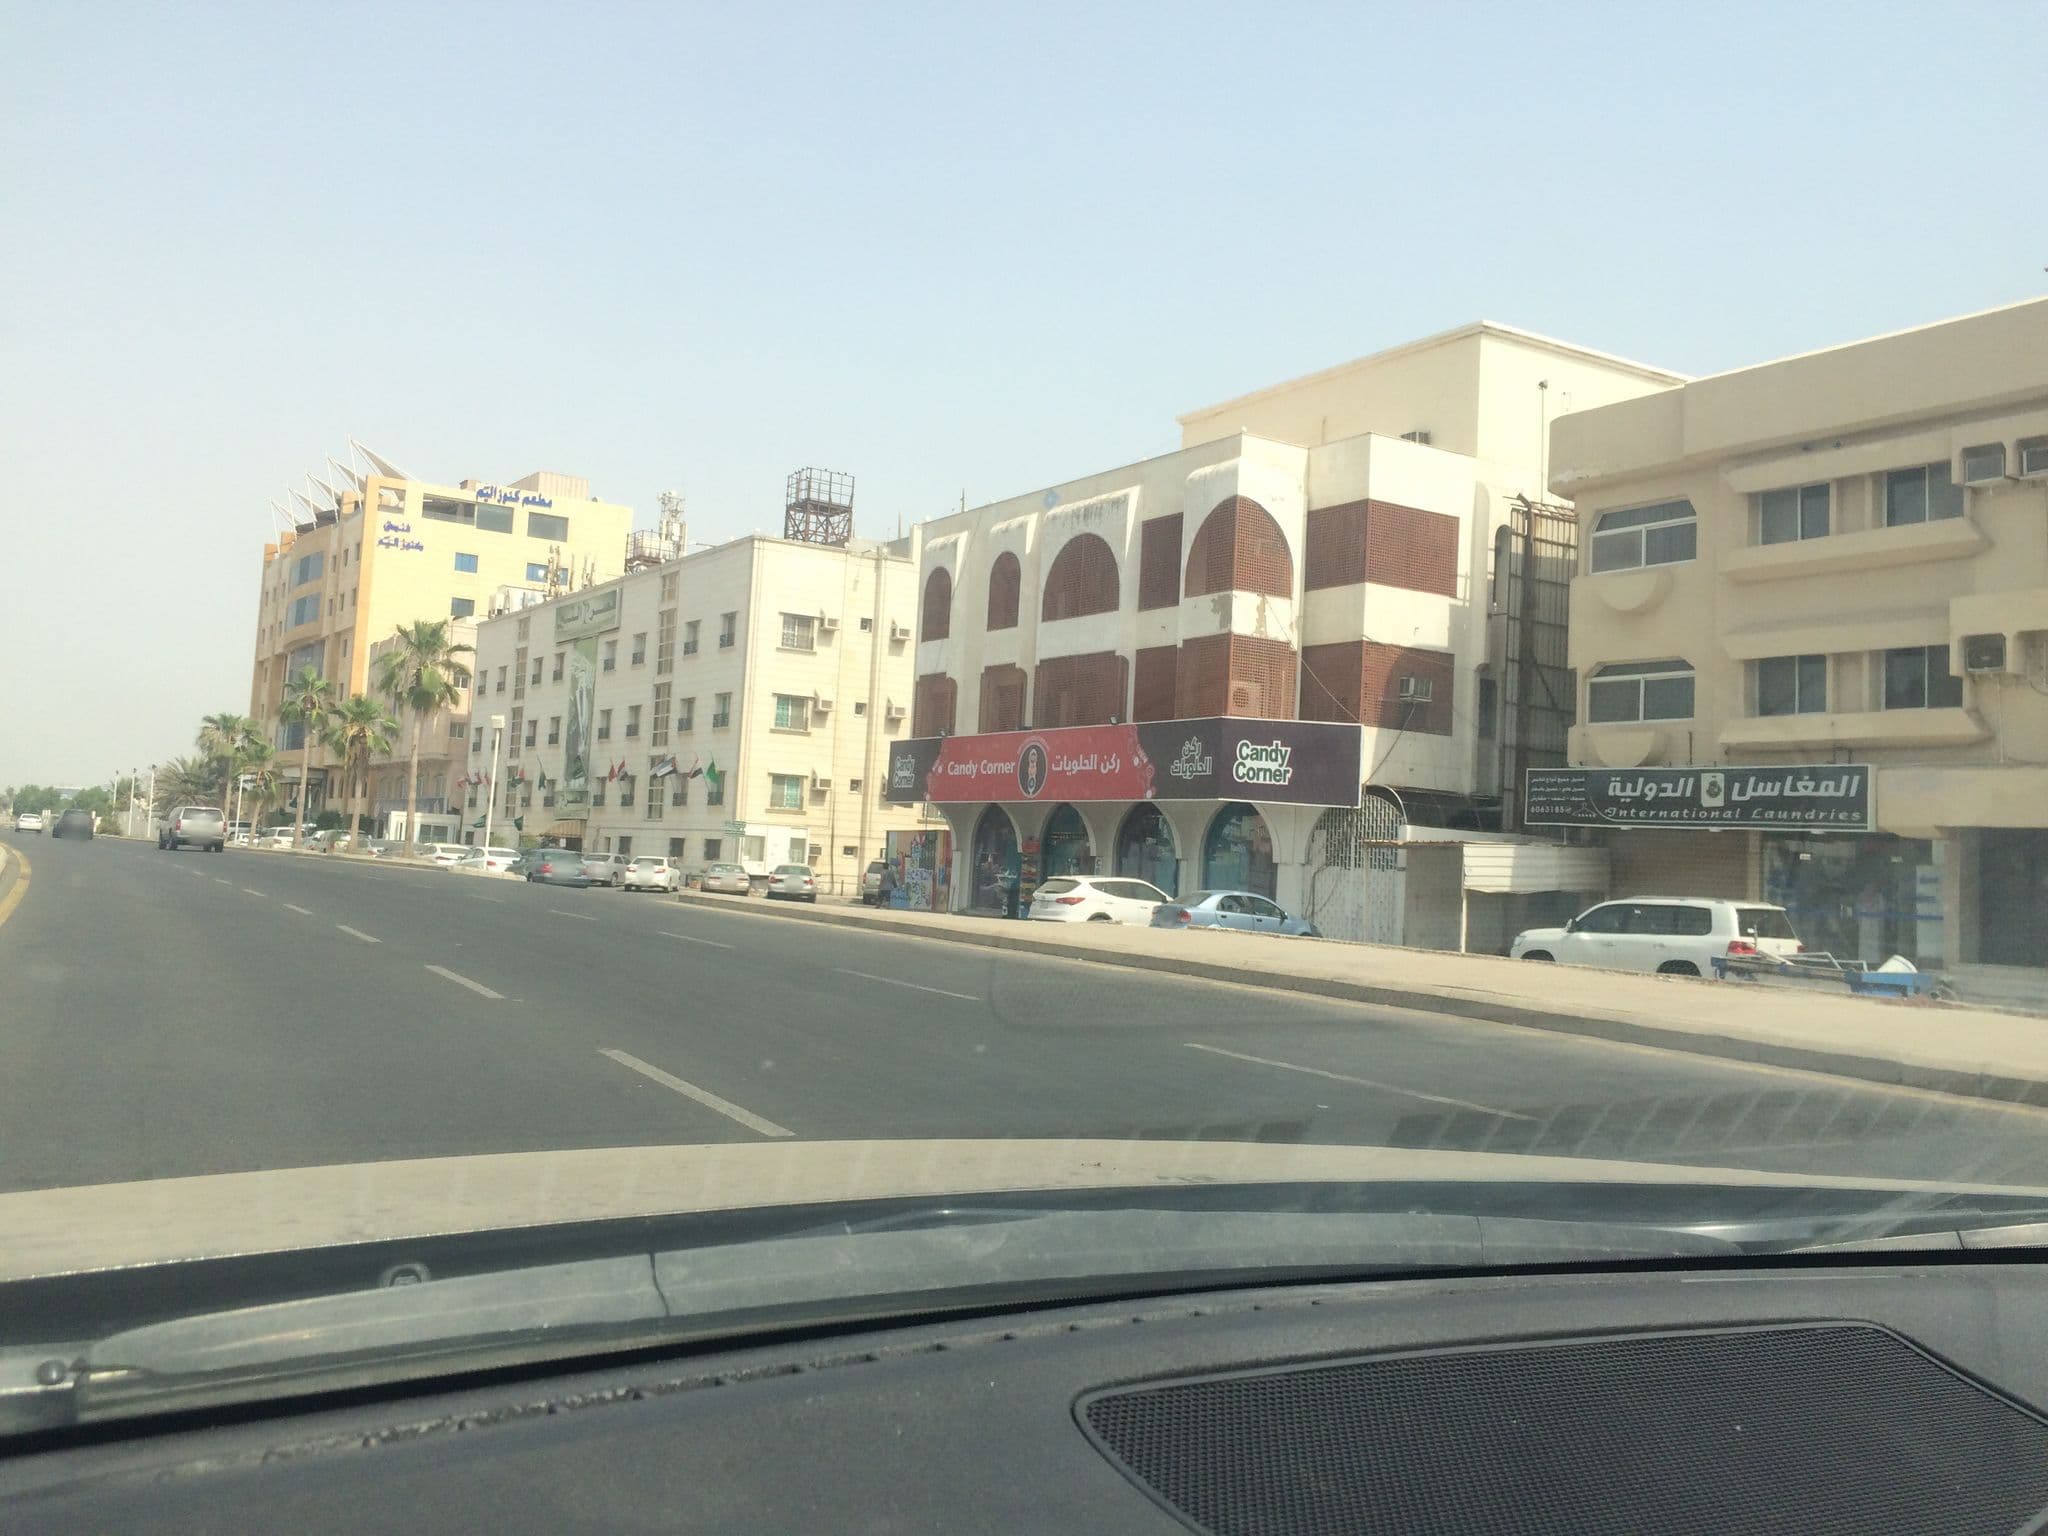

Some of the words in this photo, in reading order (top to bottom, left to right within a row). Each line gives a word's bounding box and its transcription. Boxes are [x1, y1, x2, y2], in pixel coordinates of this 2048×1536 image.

[497, 489, 521, 505] كنوز
[522, 492, 553, 508] مطعم
[383, 520, 411, 533] فندق
[1181, 736, 1202, 759] ركن
[1236, 740, 1291, 767] Candy
[894, 754, 915, 774] Candy
[947, 759, 978, 779] Candy
[980, 759, 1016, 775] Corner
[1051, 753, 1098, 776] الحلويات
[1100, 753, 1121, 774] ركن
[1170, 756, 1213, 779] الحلويات
[1233, 760, 1293, 785] Corner
[893, 771, 915, 788] Corner
[1607, 776, 1695, 803] الدولية
[1731, 775, 1860, 801] المغاسل
[1604, 806, 1742, 819] International
[1751, 807, 1862, 821] Laundries
